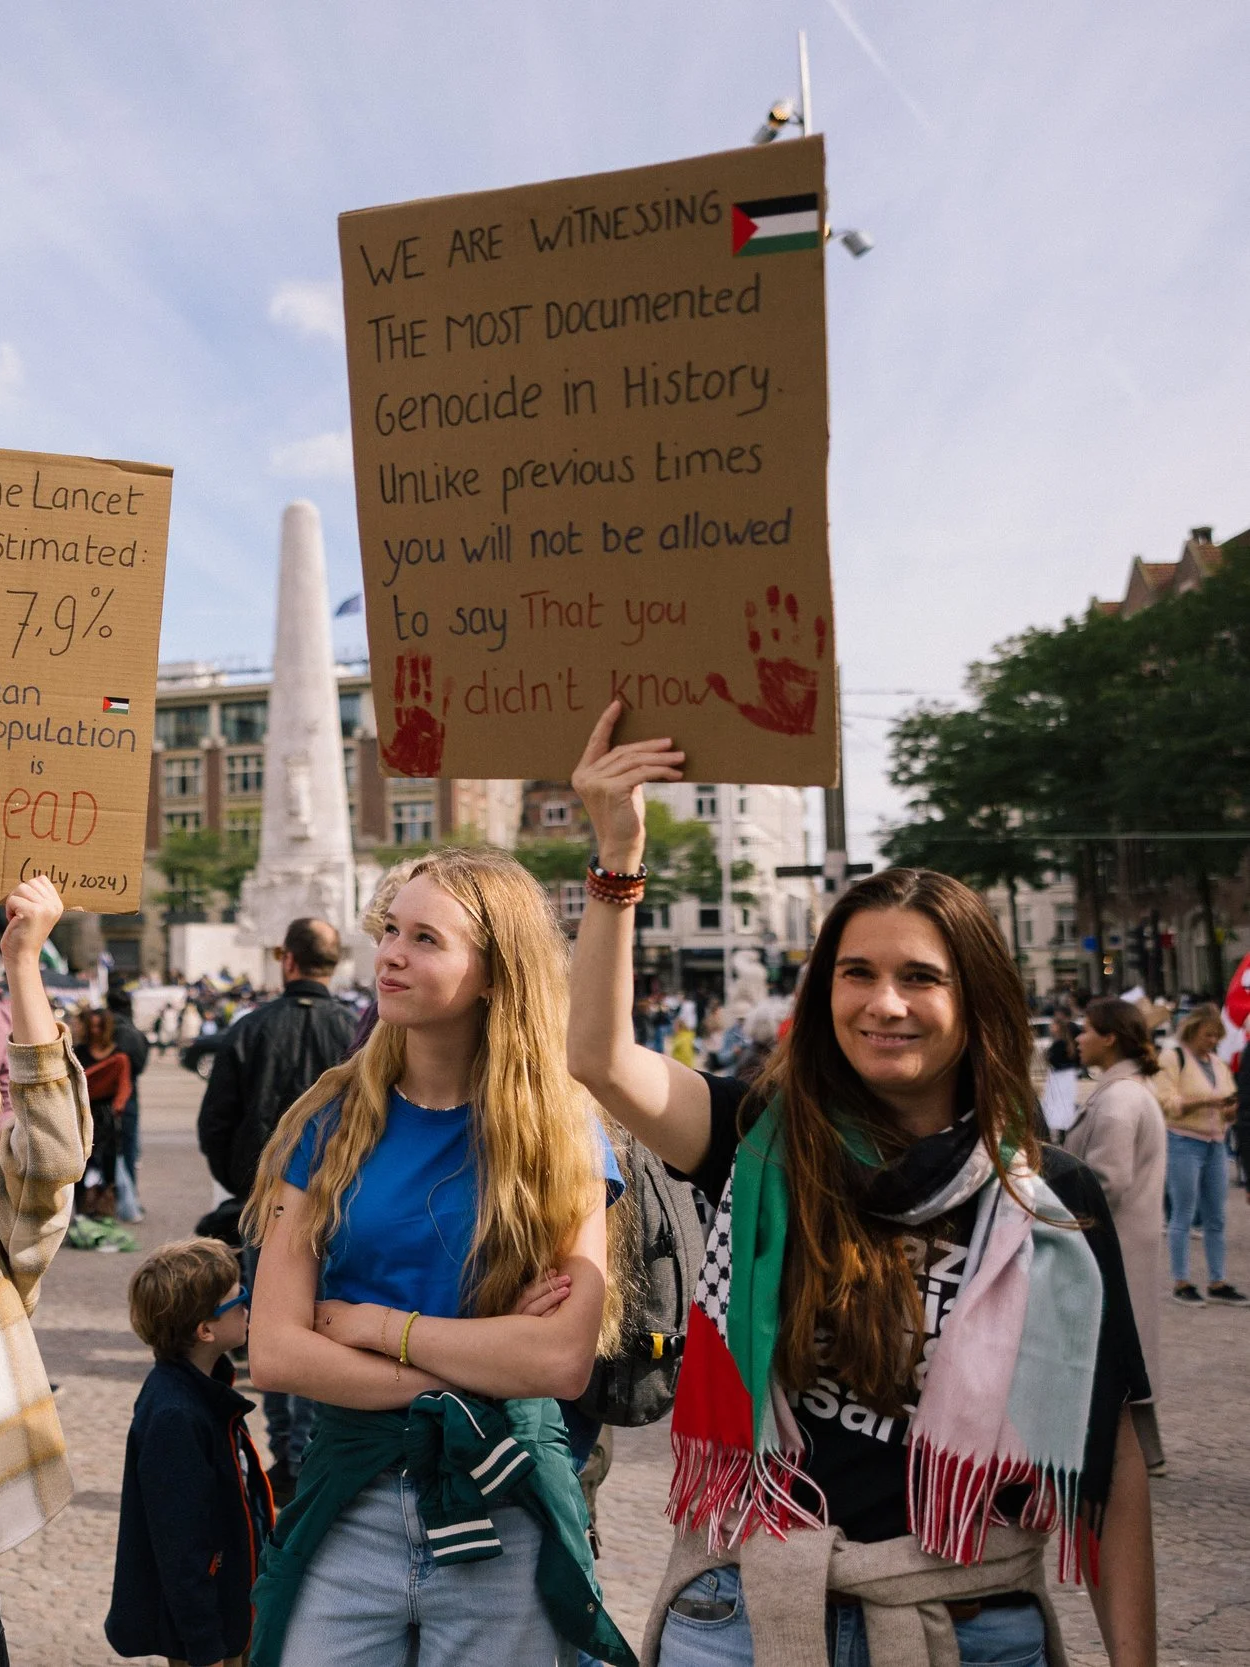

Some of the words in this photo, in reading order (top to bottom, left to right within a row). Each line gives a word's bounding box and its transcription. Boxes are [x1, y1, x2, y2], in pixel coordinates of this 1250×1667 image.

[359, 235, 426, 287] WE
[447, 224, 504, 269] ARE
[367, 314, 428, 363] THE
[446, 304, 533, 353] MOST
[374, 374, 543, 437] Genocide
[561, 368, 597, 416] in
[32, 470, 145, 516] Lancet
[502, 447, 635, 514] previous
[655, 440, 763, 483] times
[382, 536, 446, 587] you
[460, 522, 511, 564] will
[530, 521, 584, 558] not
[601, 521, 645, 555] be
[658, 506, 793, 552] allowed
[393, 593, 430, 641] to
[448, 604, 509, 653] say
[519, 589, 605, 630] That
[620, 599, 688, 647] you
[463, 667, 585, 715] didn't
[30, 755, 45, 776] is
